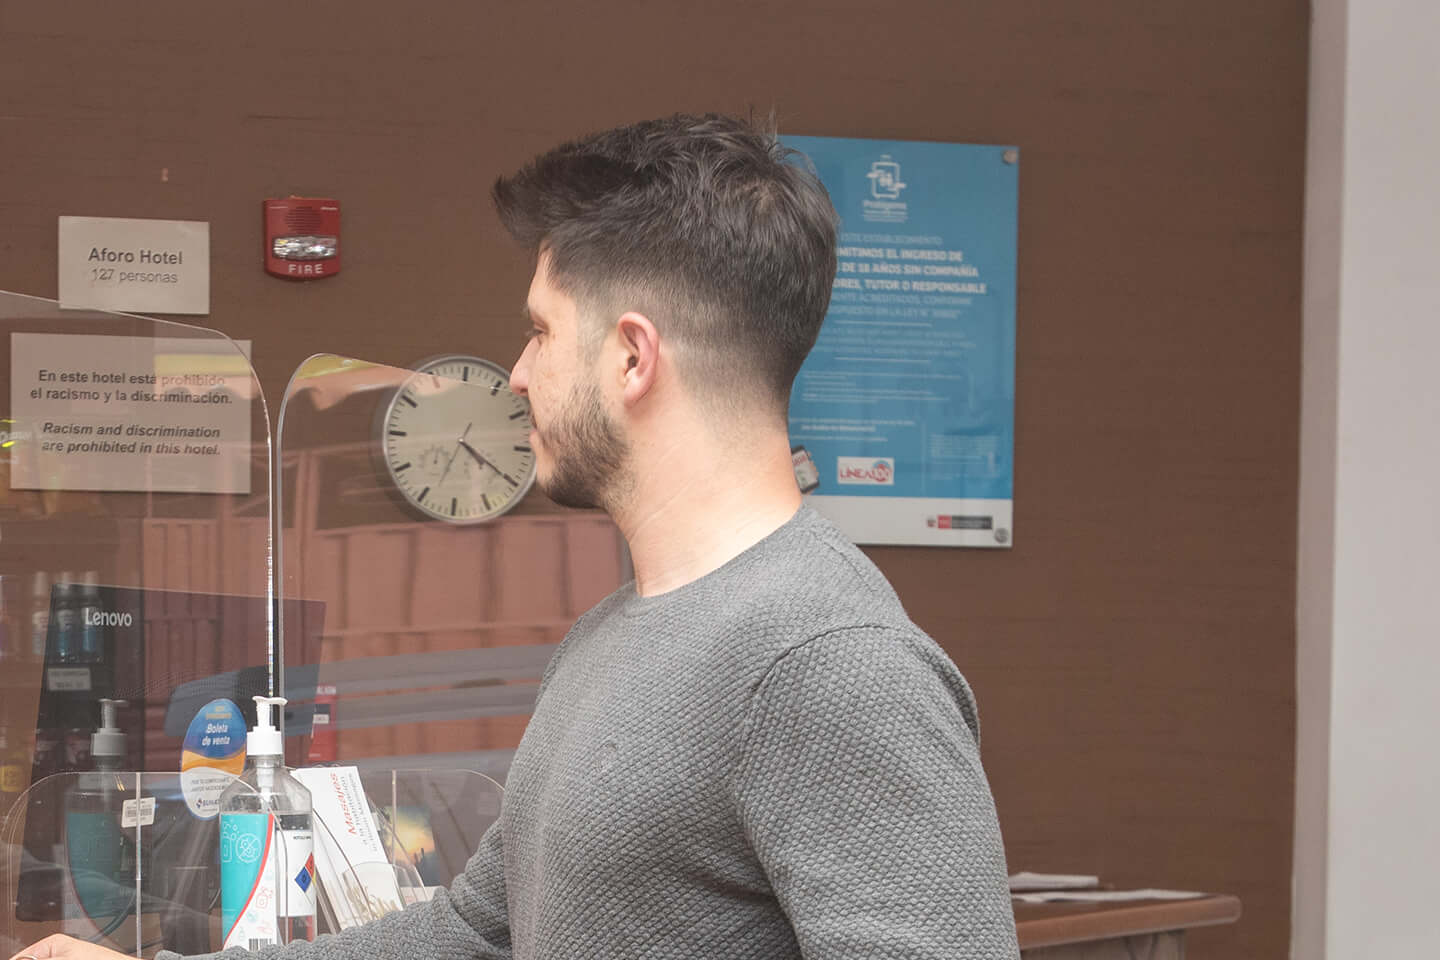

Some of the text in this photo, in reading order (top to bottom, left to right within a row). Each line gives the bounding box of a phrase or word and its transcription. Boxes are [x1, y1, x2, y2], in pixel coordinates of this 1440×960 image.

[88, 248, 183, 265] Aforo Hotel
[92, 268, 178, 284] 127 personas
[288, 264, 324, 275] FIRE
[38, 369, 56, 382] En
[60, 372, 88, 383] este
[92, 371, 125, 384] hotel
[162, 373, 225, 387] prohibido
[30, 387, 233, 404] el racismo y la discriminación.
[43, 422, 221, 438] Racism and discrimination
[42, 440, 221, 456] are prohibited in this hotel.
[85, 607, 133, 627] Lenovo
[206, 723, 229, 734] Boleta
[201, 735, 231, 746] de venta
